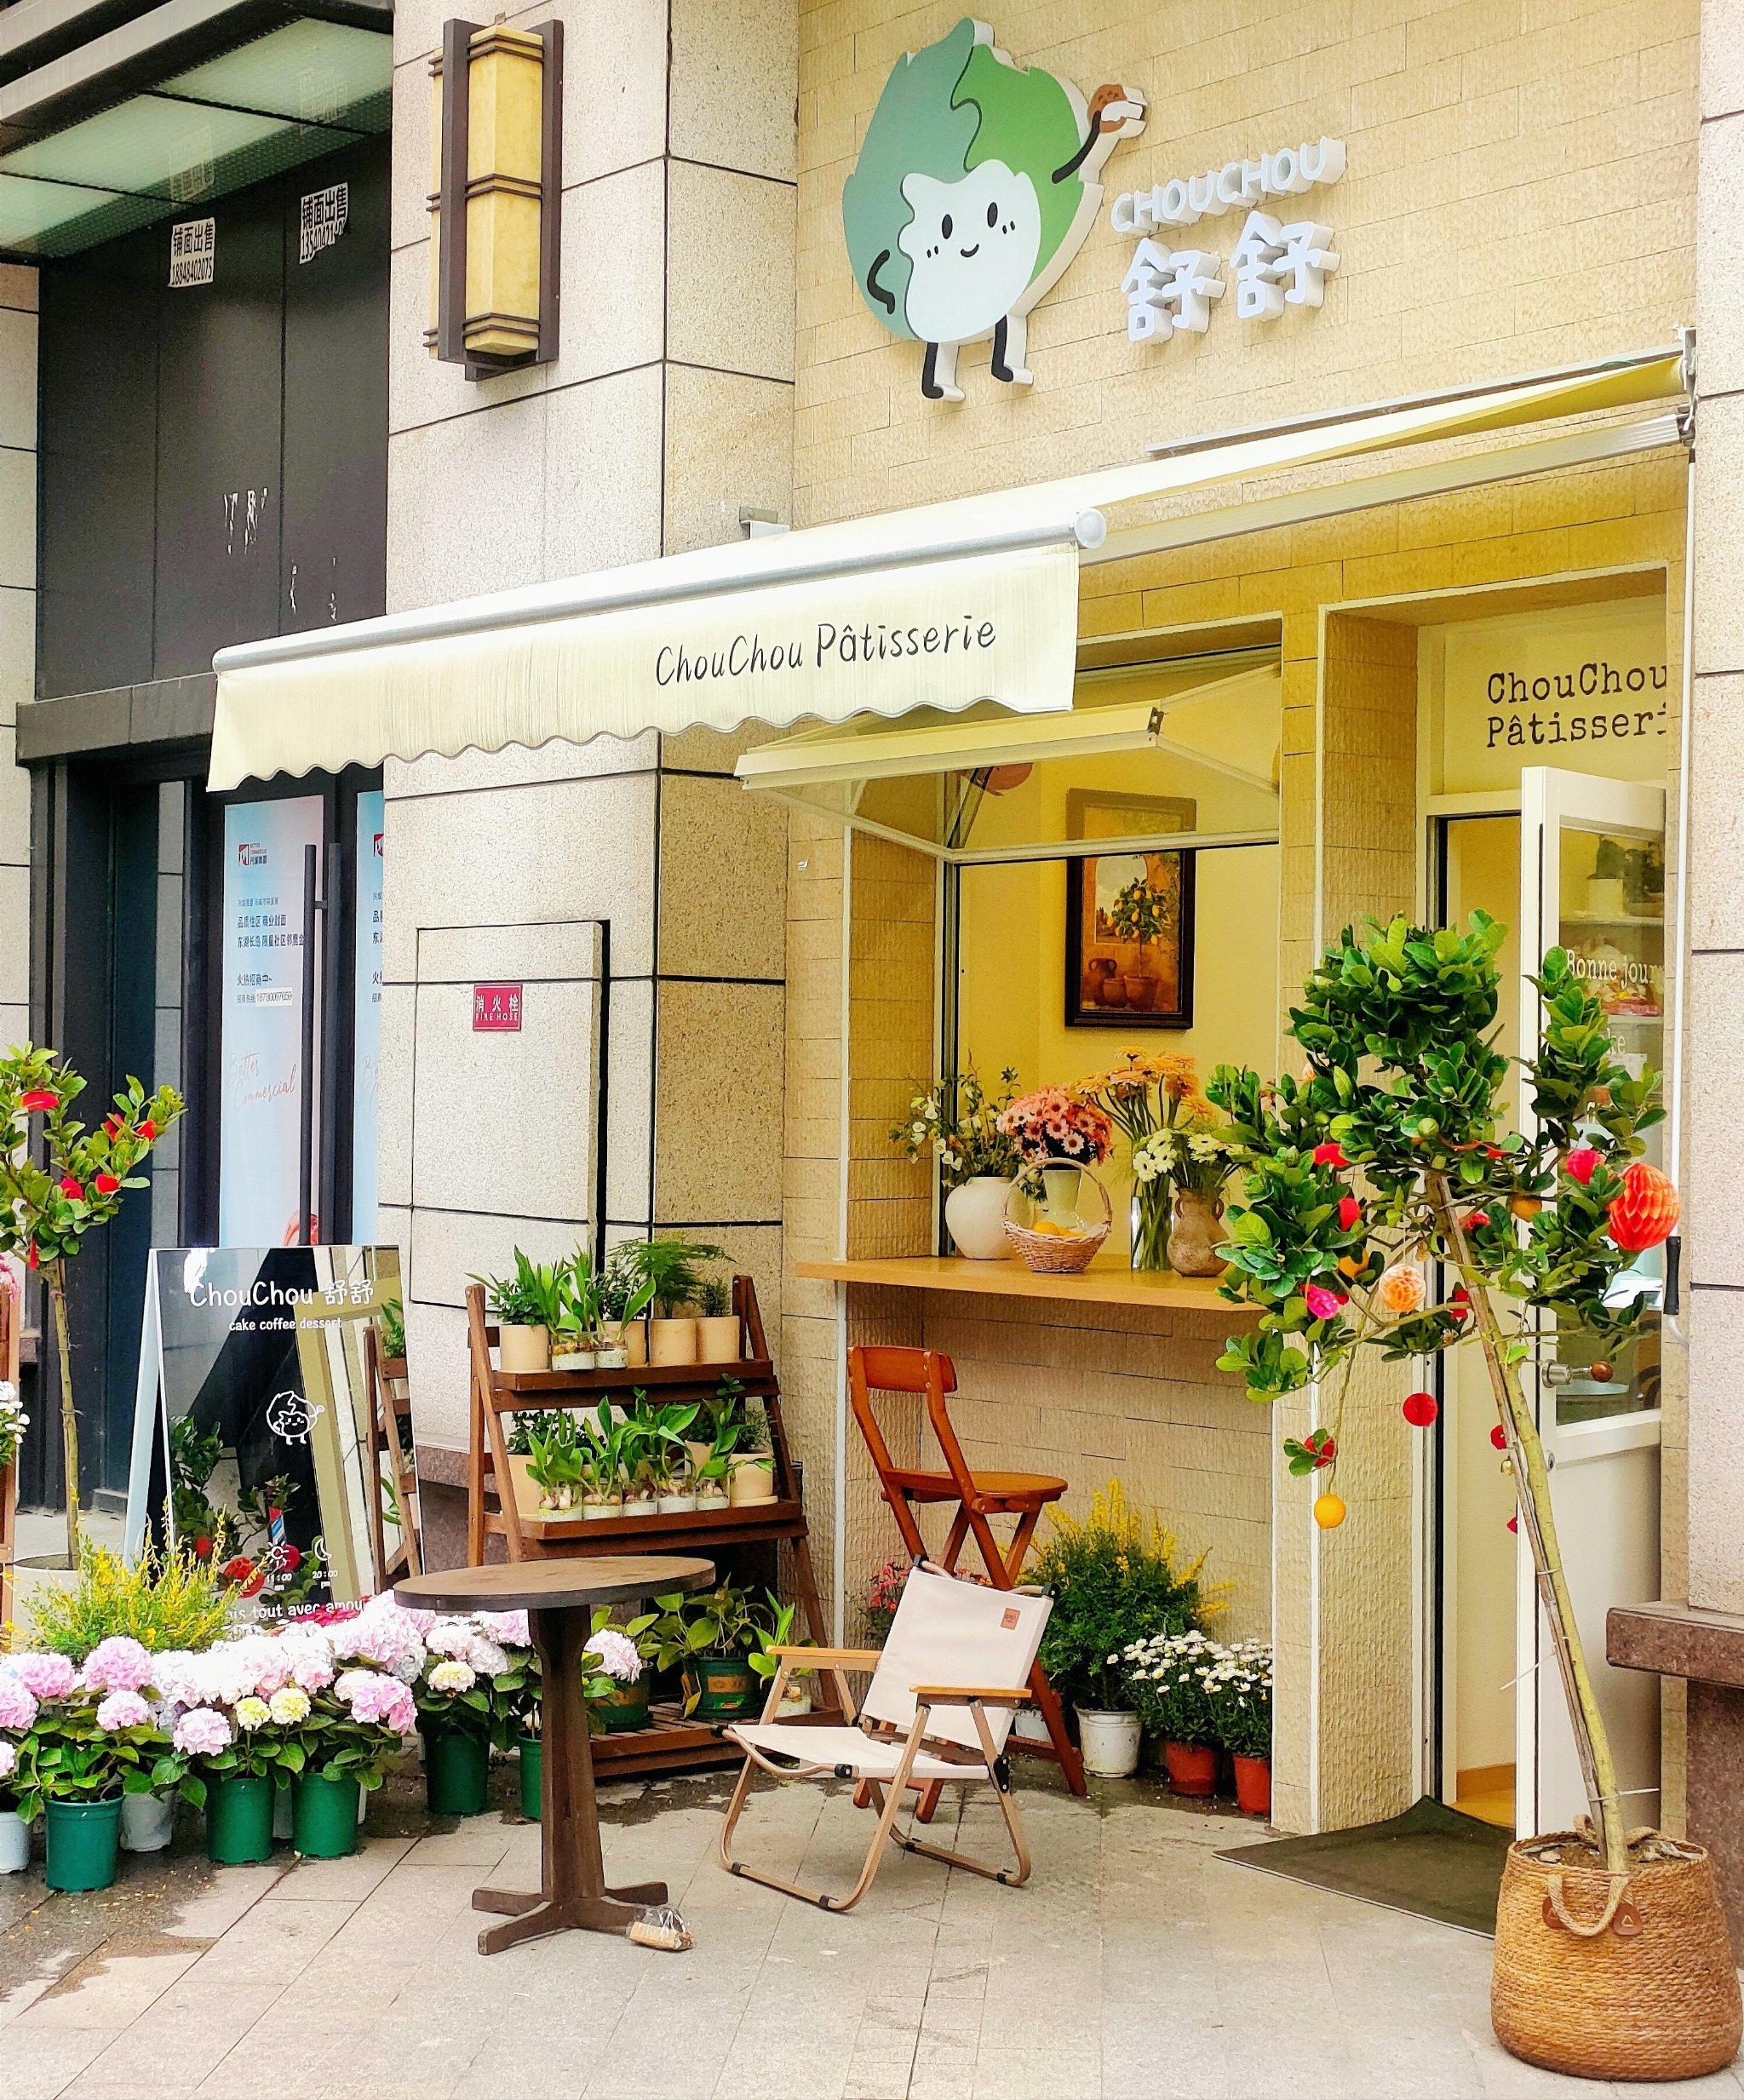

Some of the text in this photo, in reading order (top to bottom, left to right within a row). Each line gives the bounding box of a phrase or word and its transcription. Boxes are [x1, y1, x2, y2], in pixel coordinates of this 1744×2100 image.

[1111, 135, 1346, 234] CHOUCHOU
[301, 186, 347, 231] 铺面出售
[173, 221, 214, 257] 铺面出售
[1120, 209, 1340, 343] 舒舒
[656, 615, 996, 686] ChouChou Pâtisserie
[1487, 662, 1667, 704] ChouChou
[1567, 949, 1617, 980] Bonne
[476, 1013, 518, 1021] FIRE HOSE
[190, 1279, 374, 1307] ChouChou 舒舒
[229, 1317, 342, 1331] cake coffee dessert
[253, 1604, 284, 1618] tout
